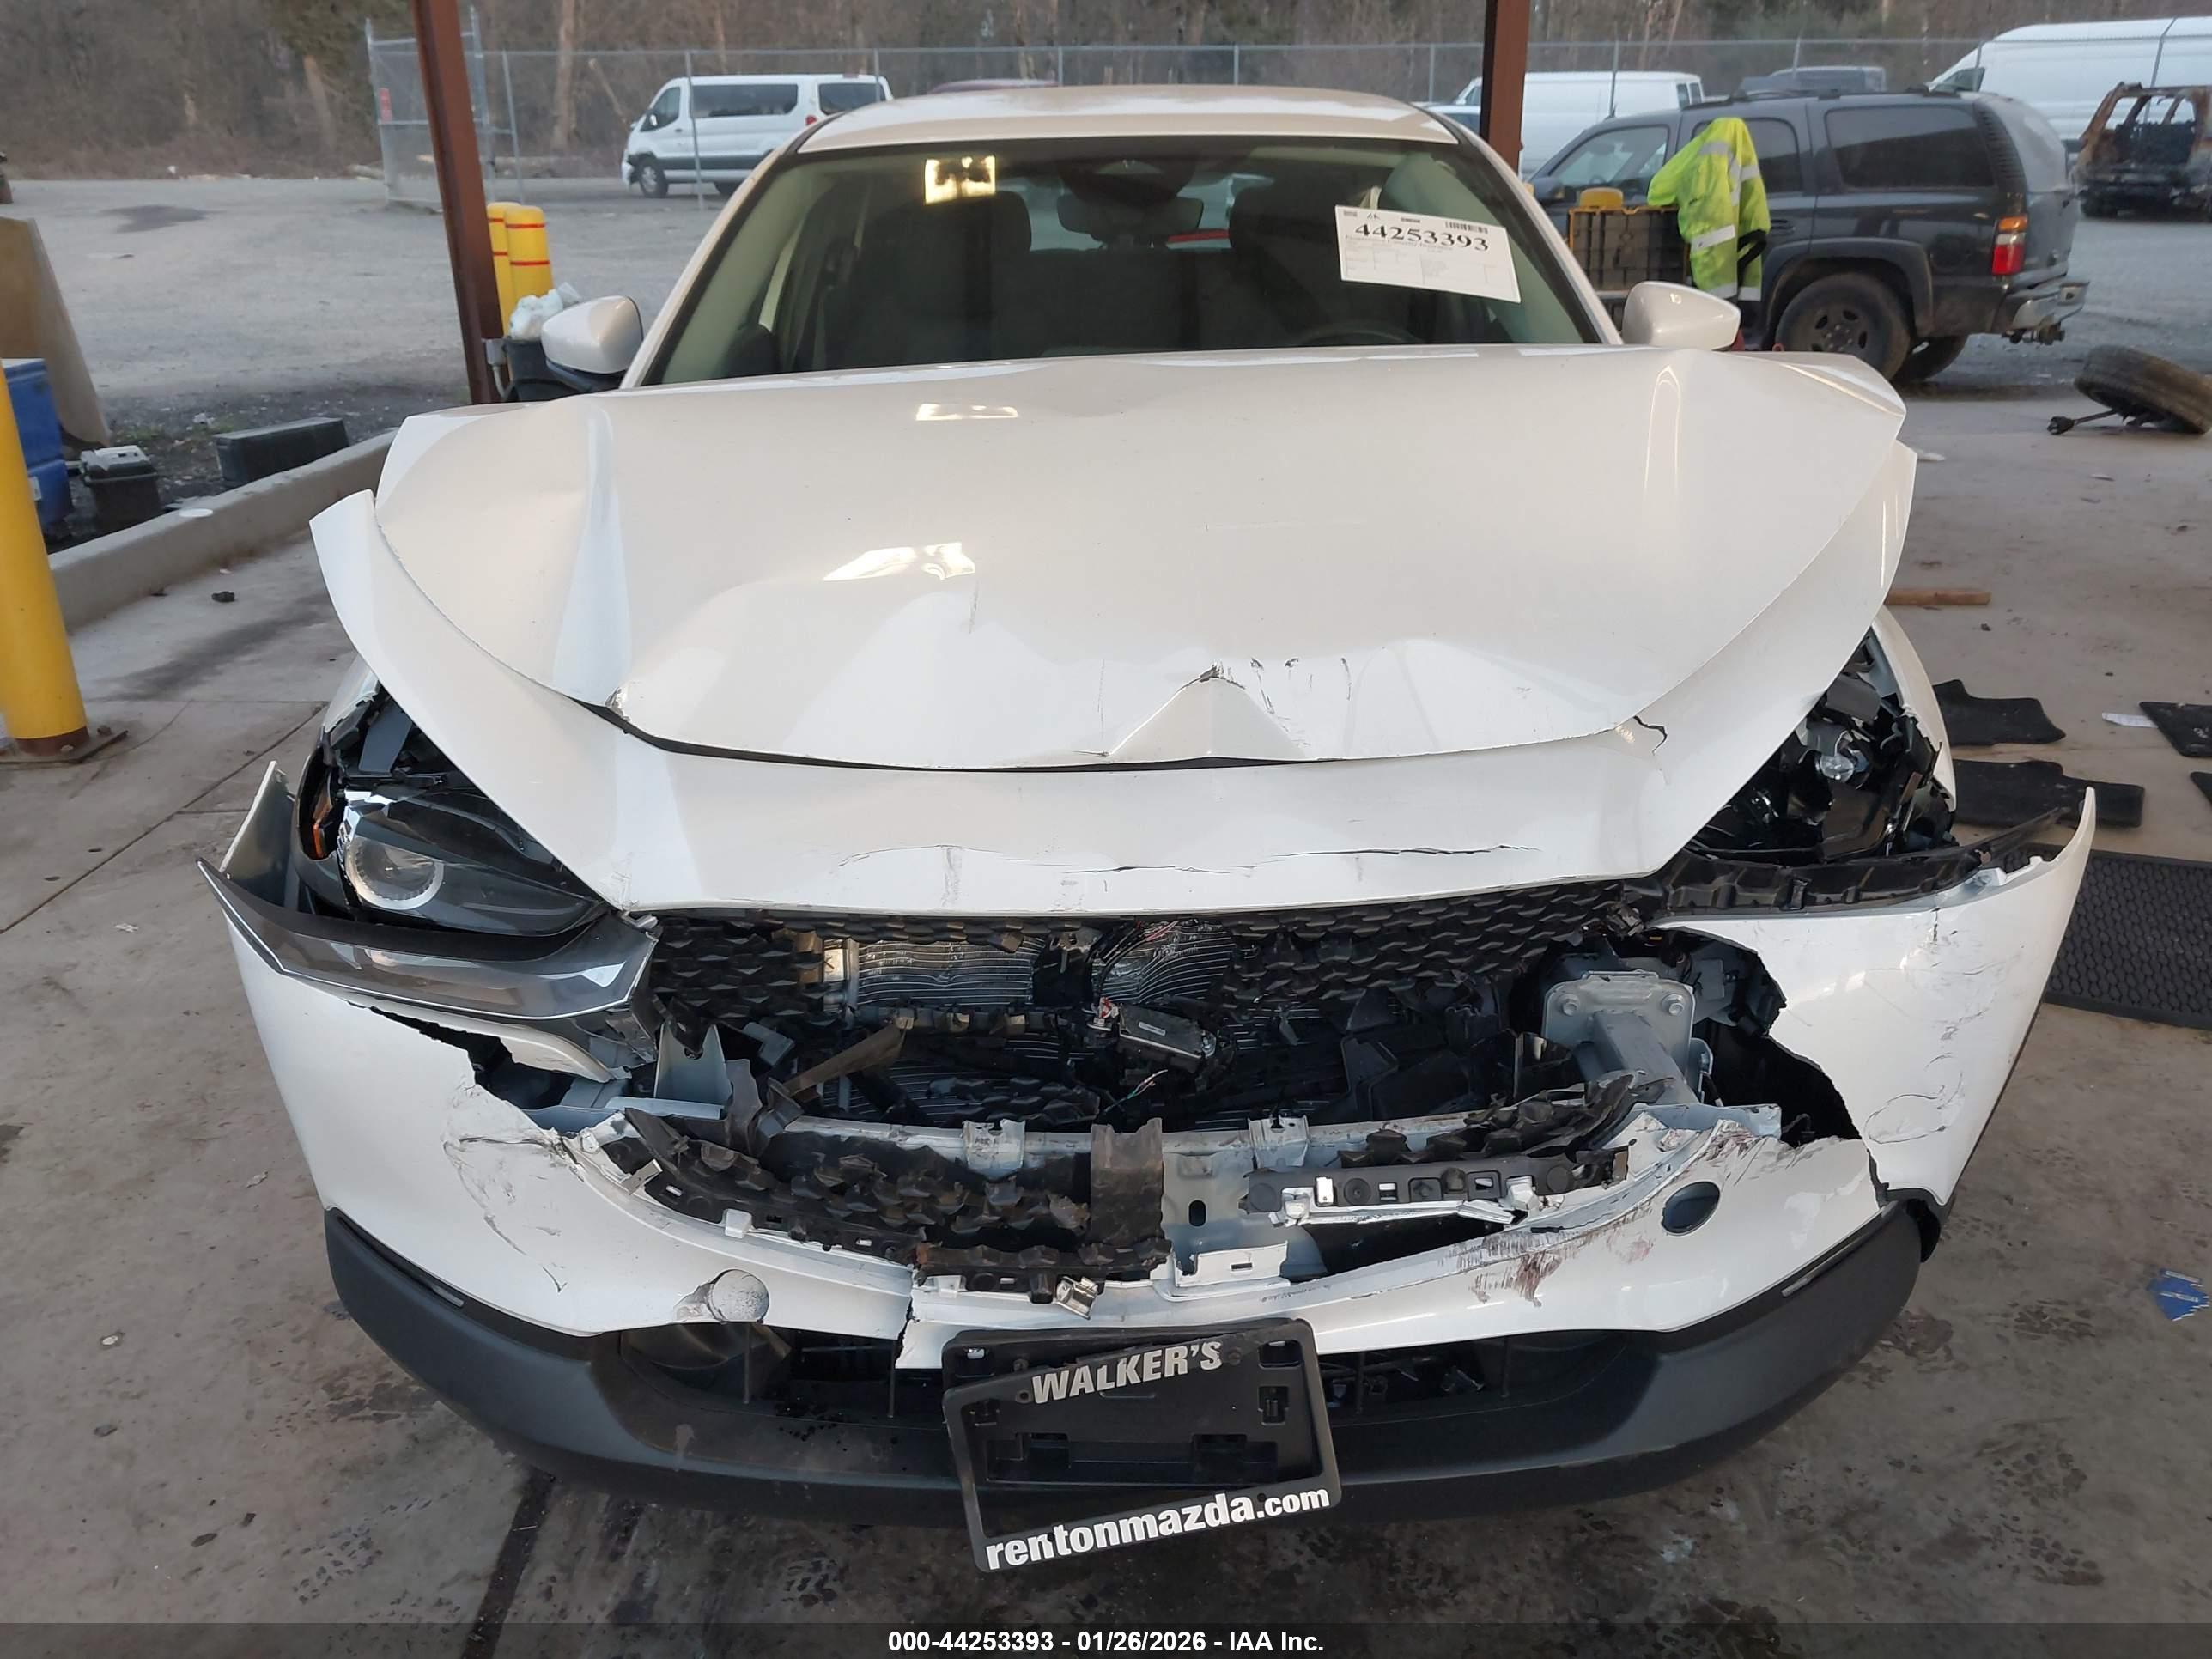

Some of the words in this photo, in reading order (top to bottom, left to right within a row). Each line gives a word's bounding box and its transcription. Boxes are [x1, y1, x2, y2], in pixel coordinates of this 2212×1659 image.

[1355, 223, 1489, 252] 44253393
[1032, 1340, 1223, 1404] WALKER'S
[986, 1487, 1330, 1571] rentonmazda.com
